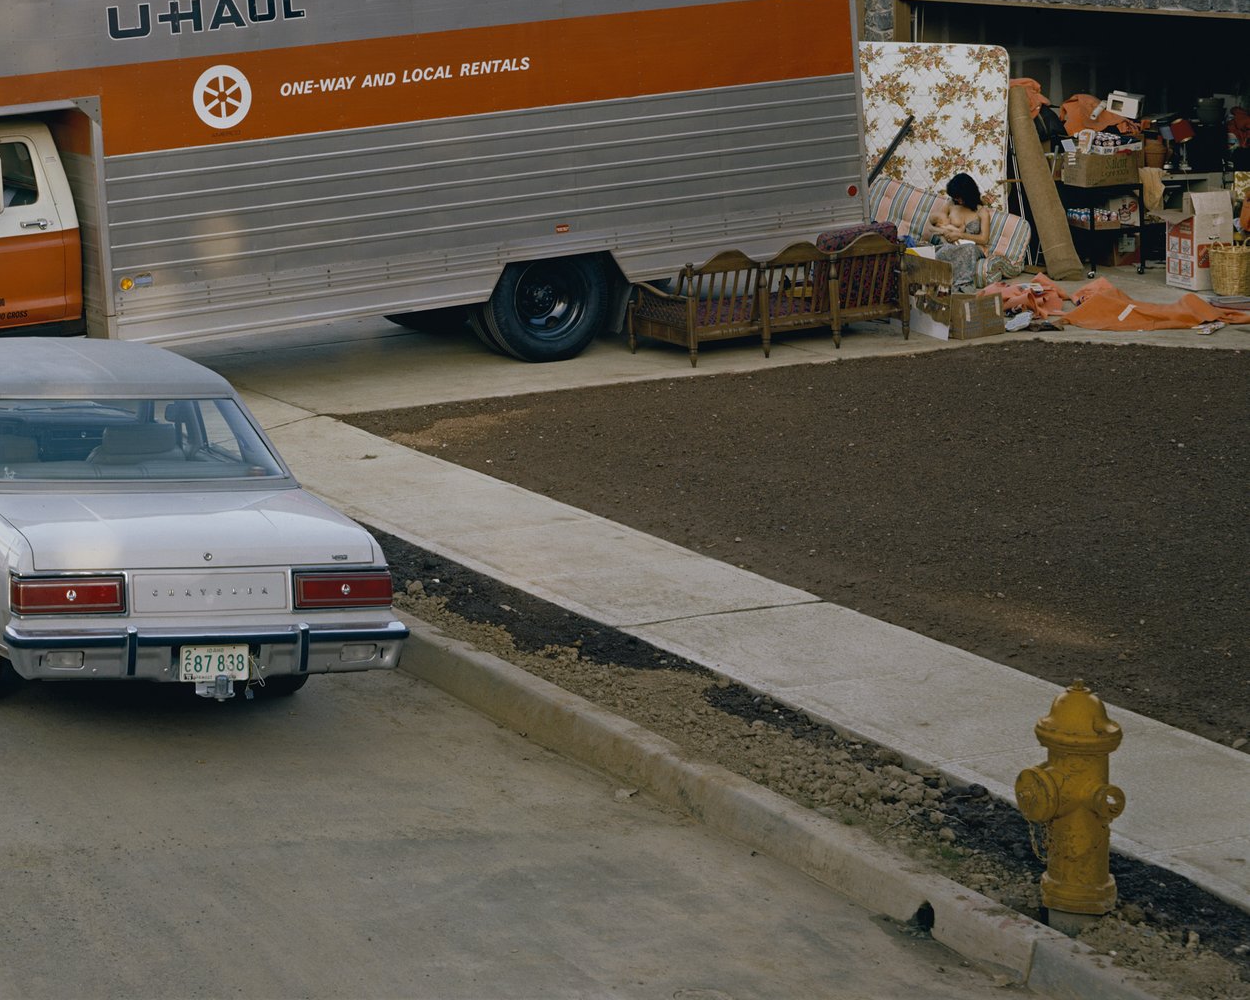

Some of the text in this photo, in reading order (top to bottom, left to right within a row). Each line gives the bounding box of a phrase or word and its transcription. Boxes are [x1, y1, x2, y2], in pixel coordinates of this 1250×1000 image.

[280, 56, 530, 97] ONE-WAY AND LOCAL RENTALS
[7, 310, 28, 320] GROSS
[152, 587, 268, 597] CHRYSLER
